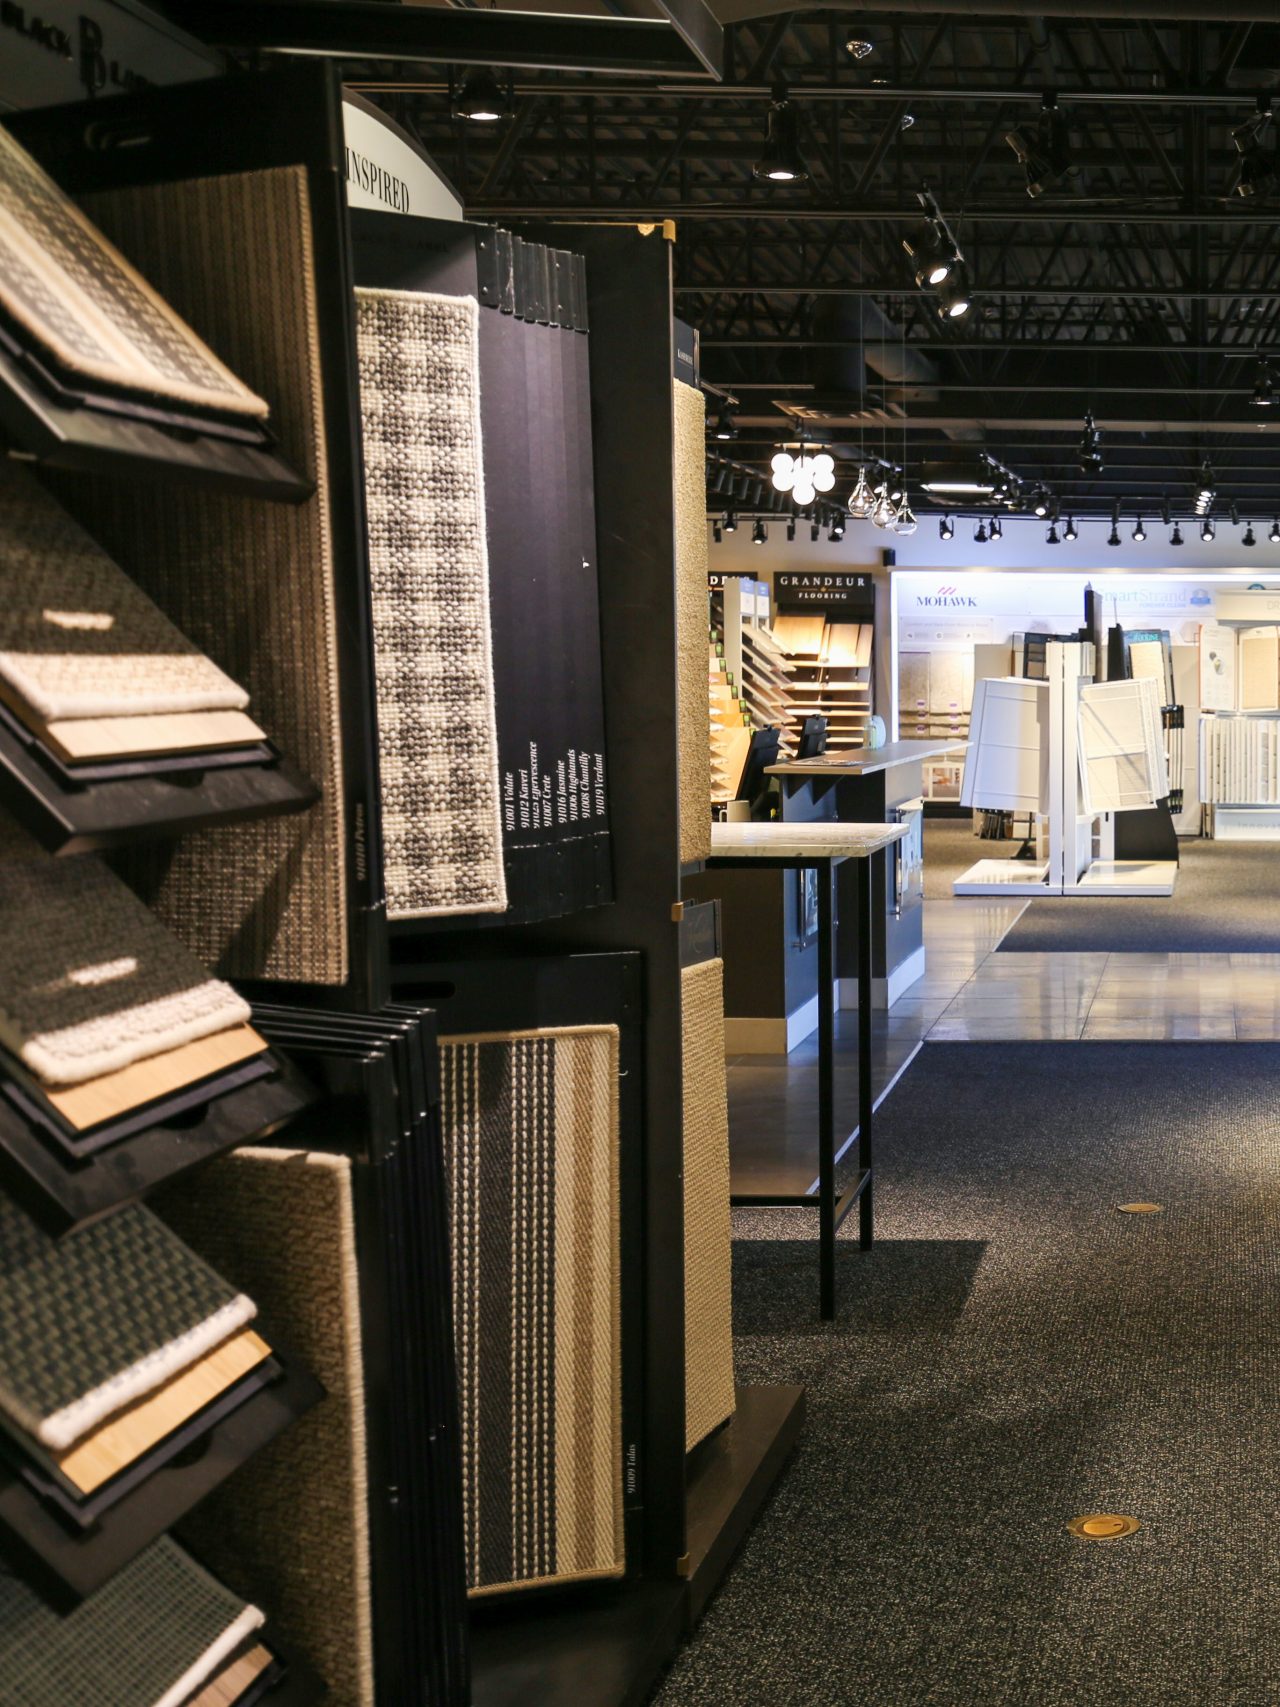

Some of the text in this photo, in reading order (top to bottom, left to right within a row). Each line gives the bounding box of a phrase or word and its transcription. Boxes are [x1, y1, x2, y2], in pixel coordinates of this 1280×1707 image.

[345, 146, 410, 214] INSPIRED
[780, 576, 866, 587] GRANDEUR
[798, 592, 848, 600] FLOORING
[916, 596, 977, 607] MOHAWK
[518, 769, 530, 828] 91012 Kaveri
[556, 760, 568, 823] 91016 Jasmine
[579, 751, 591, 791] Chantilly
[593, 753, 605, 816] 91019 Verdant
[503, 772, 515, 831] 91001 Volute
[542, 774, 552, 827] 91007 Crete
